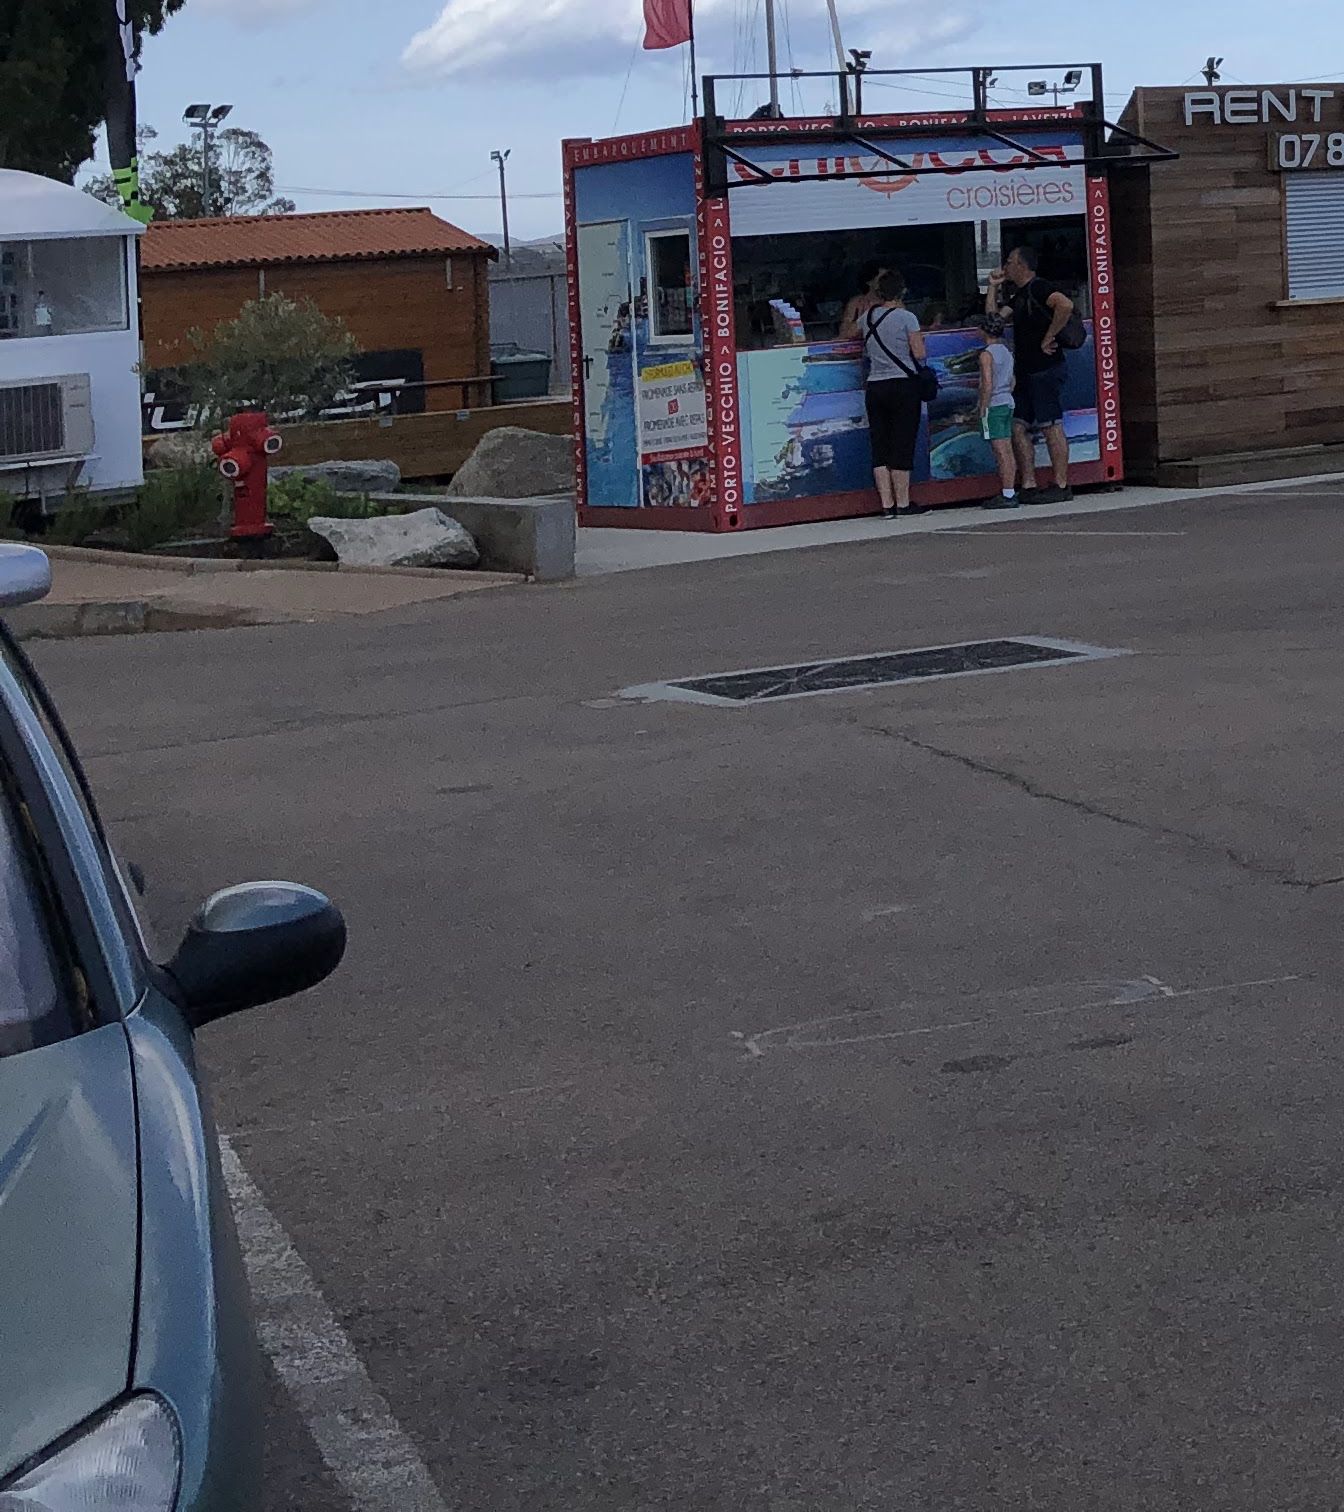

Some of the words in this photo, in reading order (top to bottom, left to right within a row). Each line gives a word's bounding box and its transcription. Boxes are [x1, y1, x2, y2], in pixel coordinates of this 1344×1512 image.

[1184, 89, 1334, 126] RENT
[573, 134, 686, 162] EMBARQUEMENT
[1279, 133, 1320, 168] 07
[946, 175, 1075, 210] croisières
[1093, 205, 1110, 294] BONIFACIO
[712, 235, 731, 337] BONIFACIO
[1099, 316, 1118, 451] PORTO-VECCHIO
[718, 362, 738, 513] PORTO-VECCHIO
